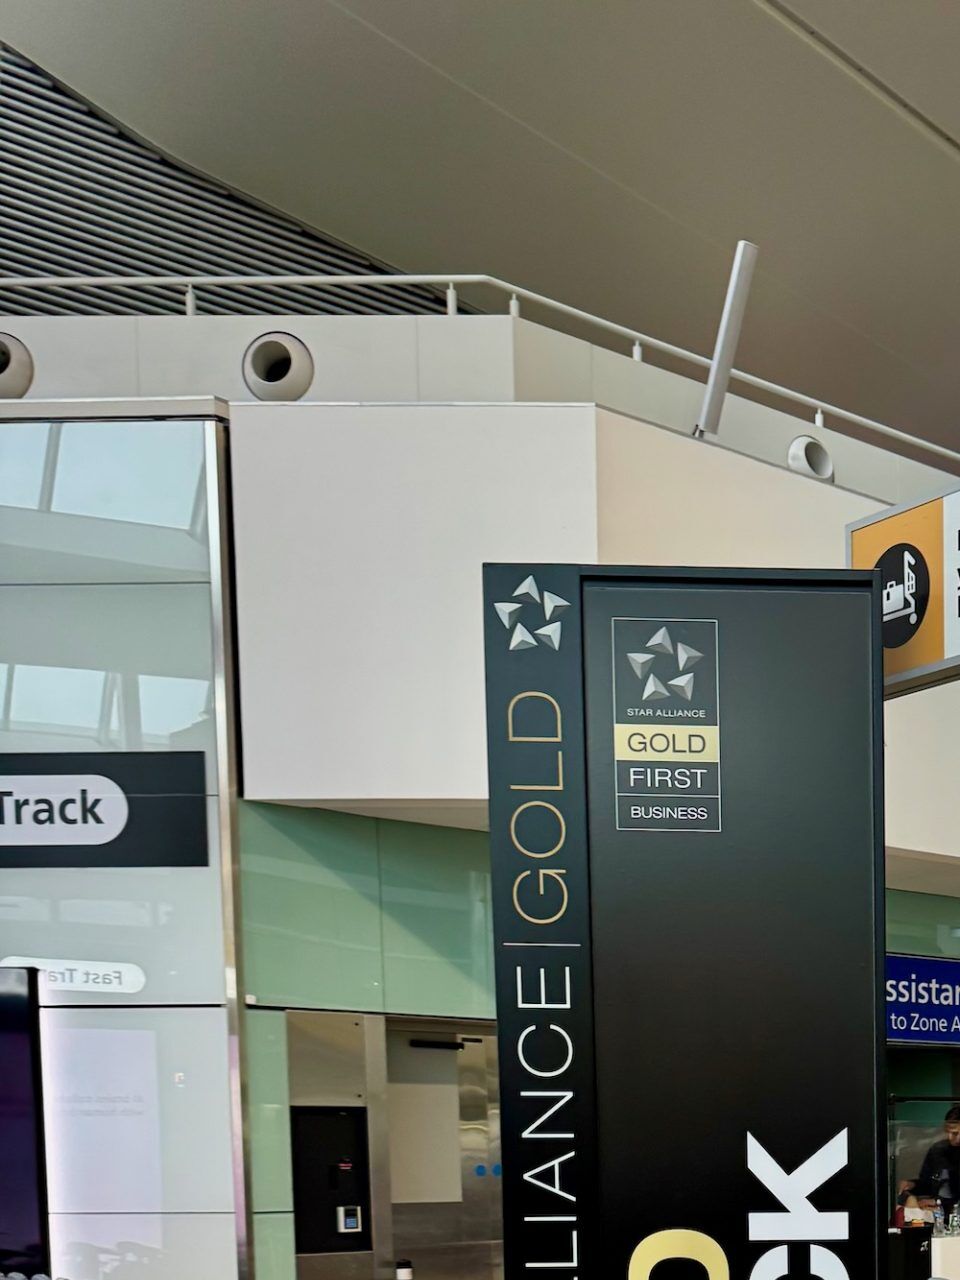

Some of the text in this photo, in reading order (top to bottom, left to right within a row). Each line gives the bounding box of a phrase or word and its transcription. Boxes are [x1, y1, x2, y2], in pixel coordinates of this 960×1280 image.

[627, 708, 706, 718] STAR ALLIANCE
[627, 732, 706, 753] GOLD
[629, 768, 707, 788] FIRST
[0, 789, 104, 825] Track
[507, 690, 569, 925] GOLD
[630, 806, 708, 819] BUSINESS
[890, 1013, 907, 1030] to
[911, 1013, 948, 1032] Zone
